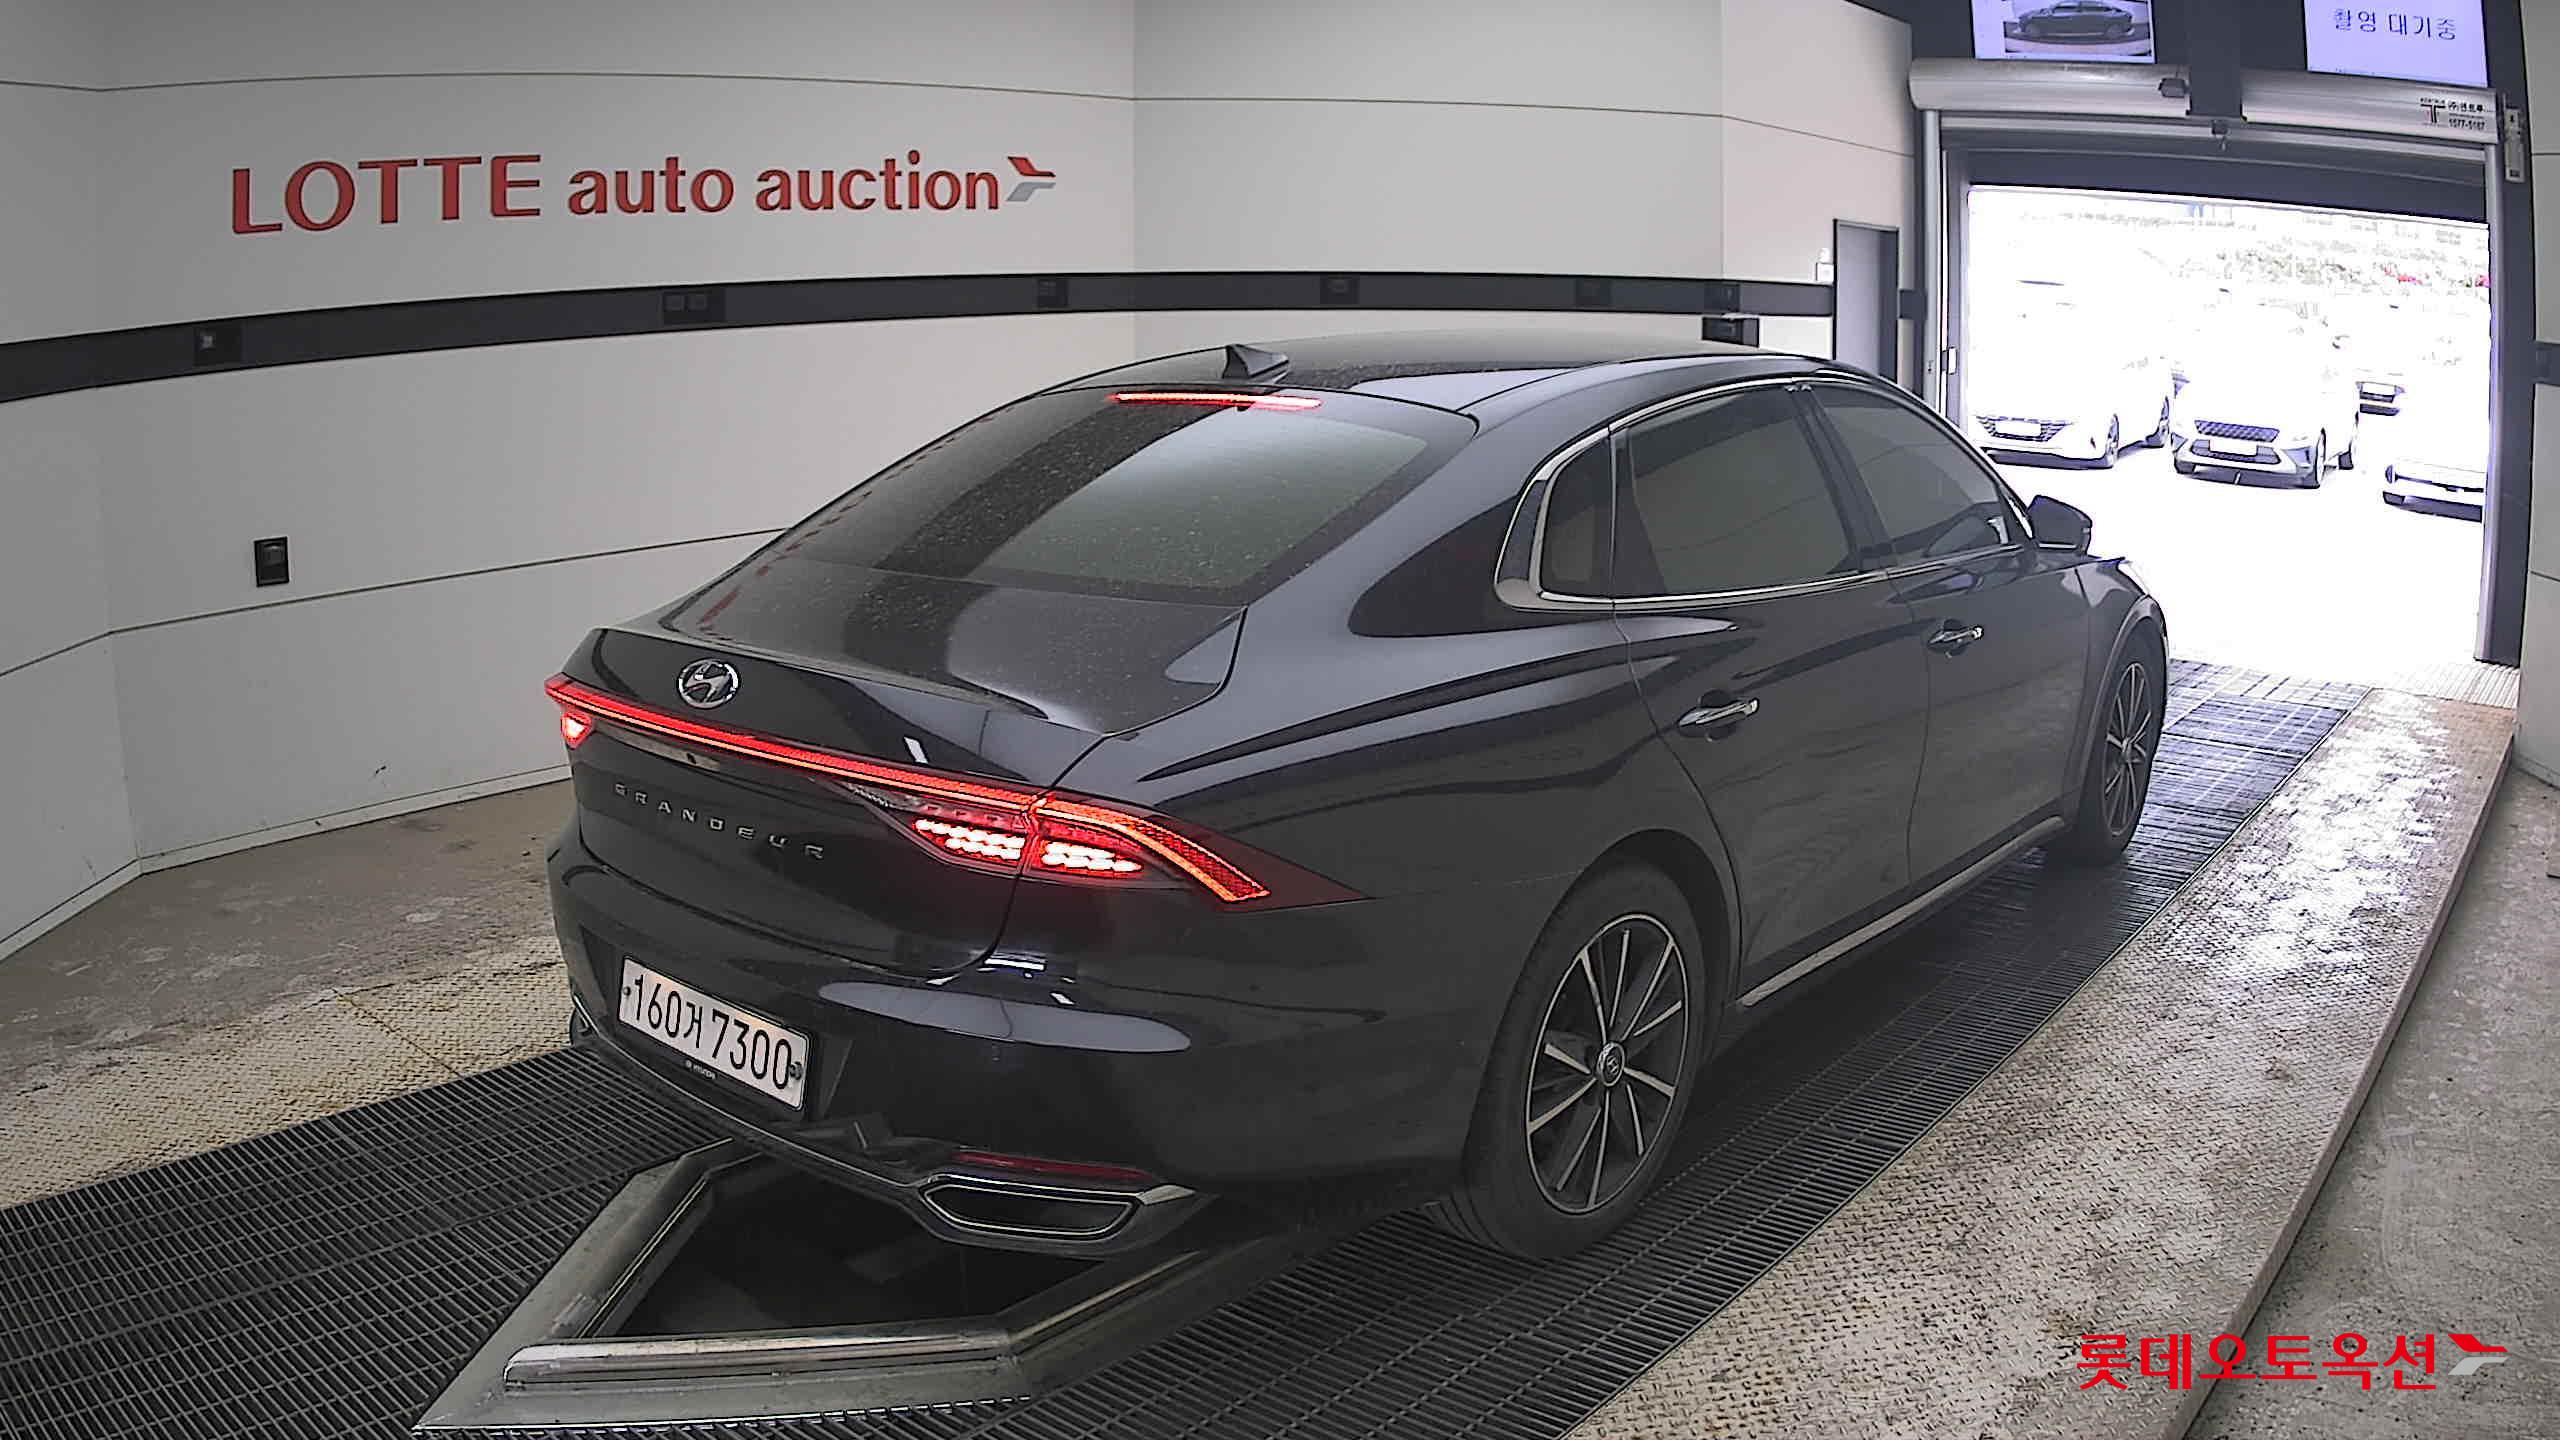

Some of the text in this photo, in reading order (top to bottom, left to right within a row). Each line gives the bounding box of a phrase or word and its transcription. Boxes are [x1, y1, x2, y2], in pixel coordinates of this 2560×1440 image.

[2335, 8, 2456, 41] 촬영 대기중
[232, 150, 1001, 234] LOTTE auto auction
[613, 783, 825, 860] GRANDEUR
